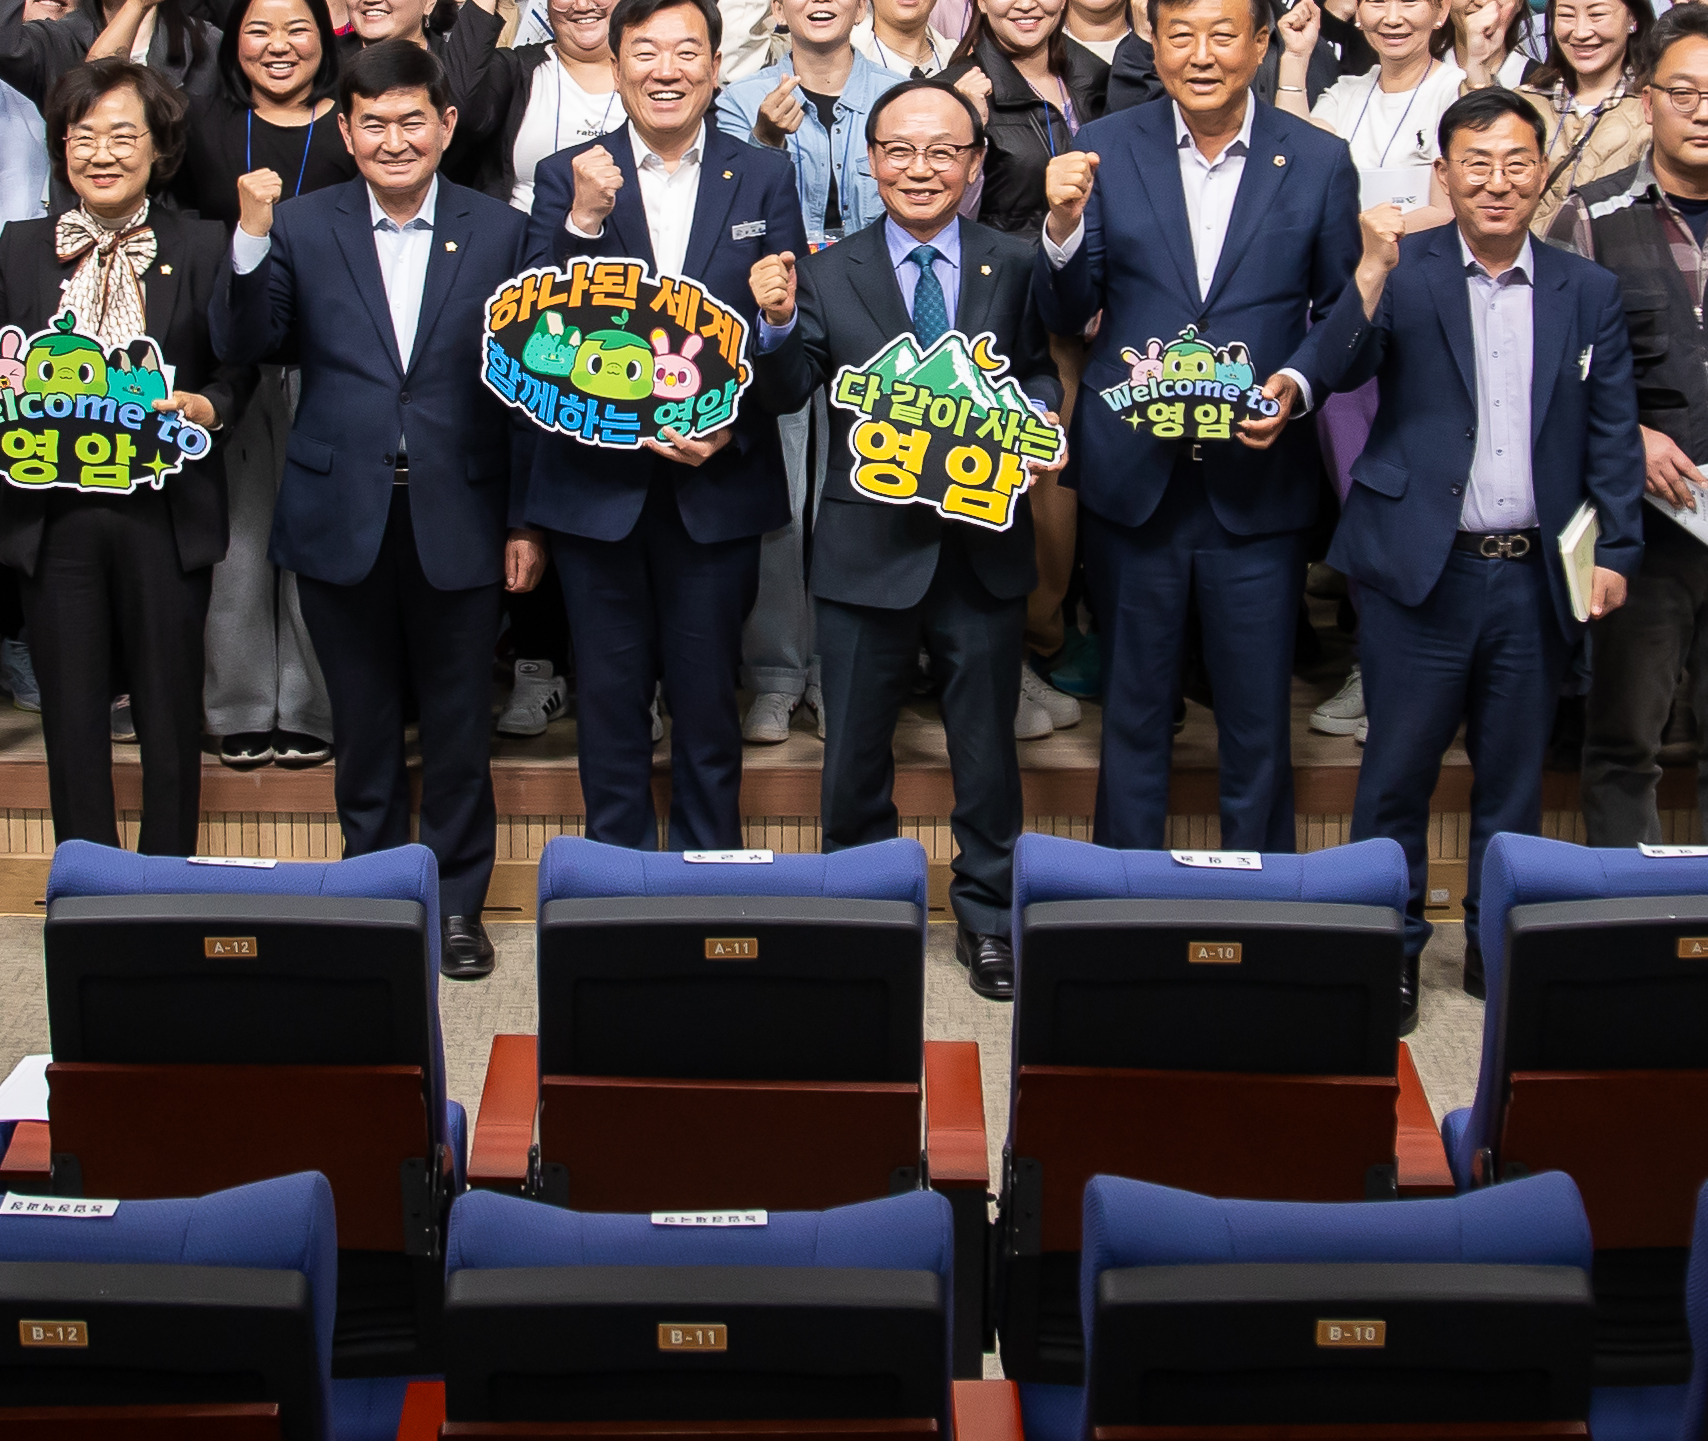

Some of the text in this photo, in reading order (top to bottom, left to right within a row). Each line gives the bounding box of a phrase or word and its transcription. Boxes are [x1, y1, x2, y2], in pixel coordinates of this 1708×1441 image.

[491, 262, 642, 332] 하나된
[487, 338, 642, 443] 함께하는
[1102, 378, 1280, 417] Welcome to
[156, 410, 208, 456] to
[975, 408, 1060, 461] 사는
[214, 942, 249, 954] A-12
[714, 942, 748, 955] A-11
[1198, 947, 1234, 960] A-10
[32, 1326, 78, 1341] B-12
[671, 1330, 715, 1345] B-11
[1329, 1326, 1376, 1341] B-10
